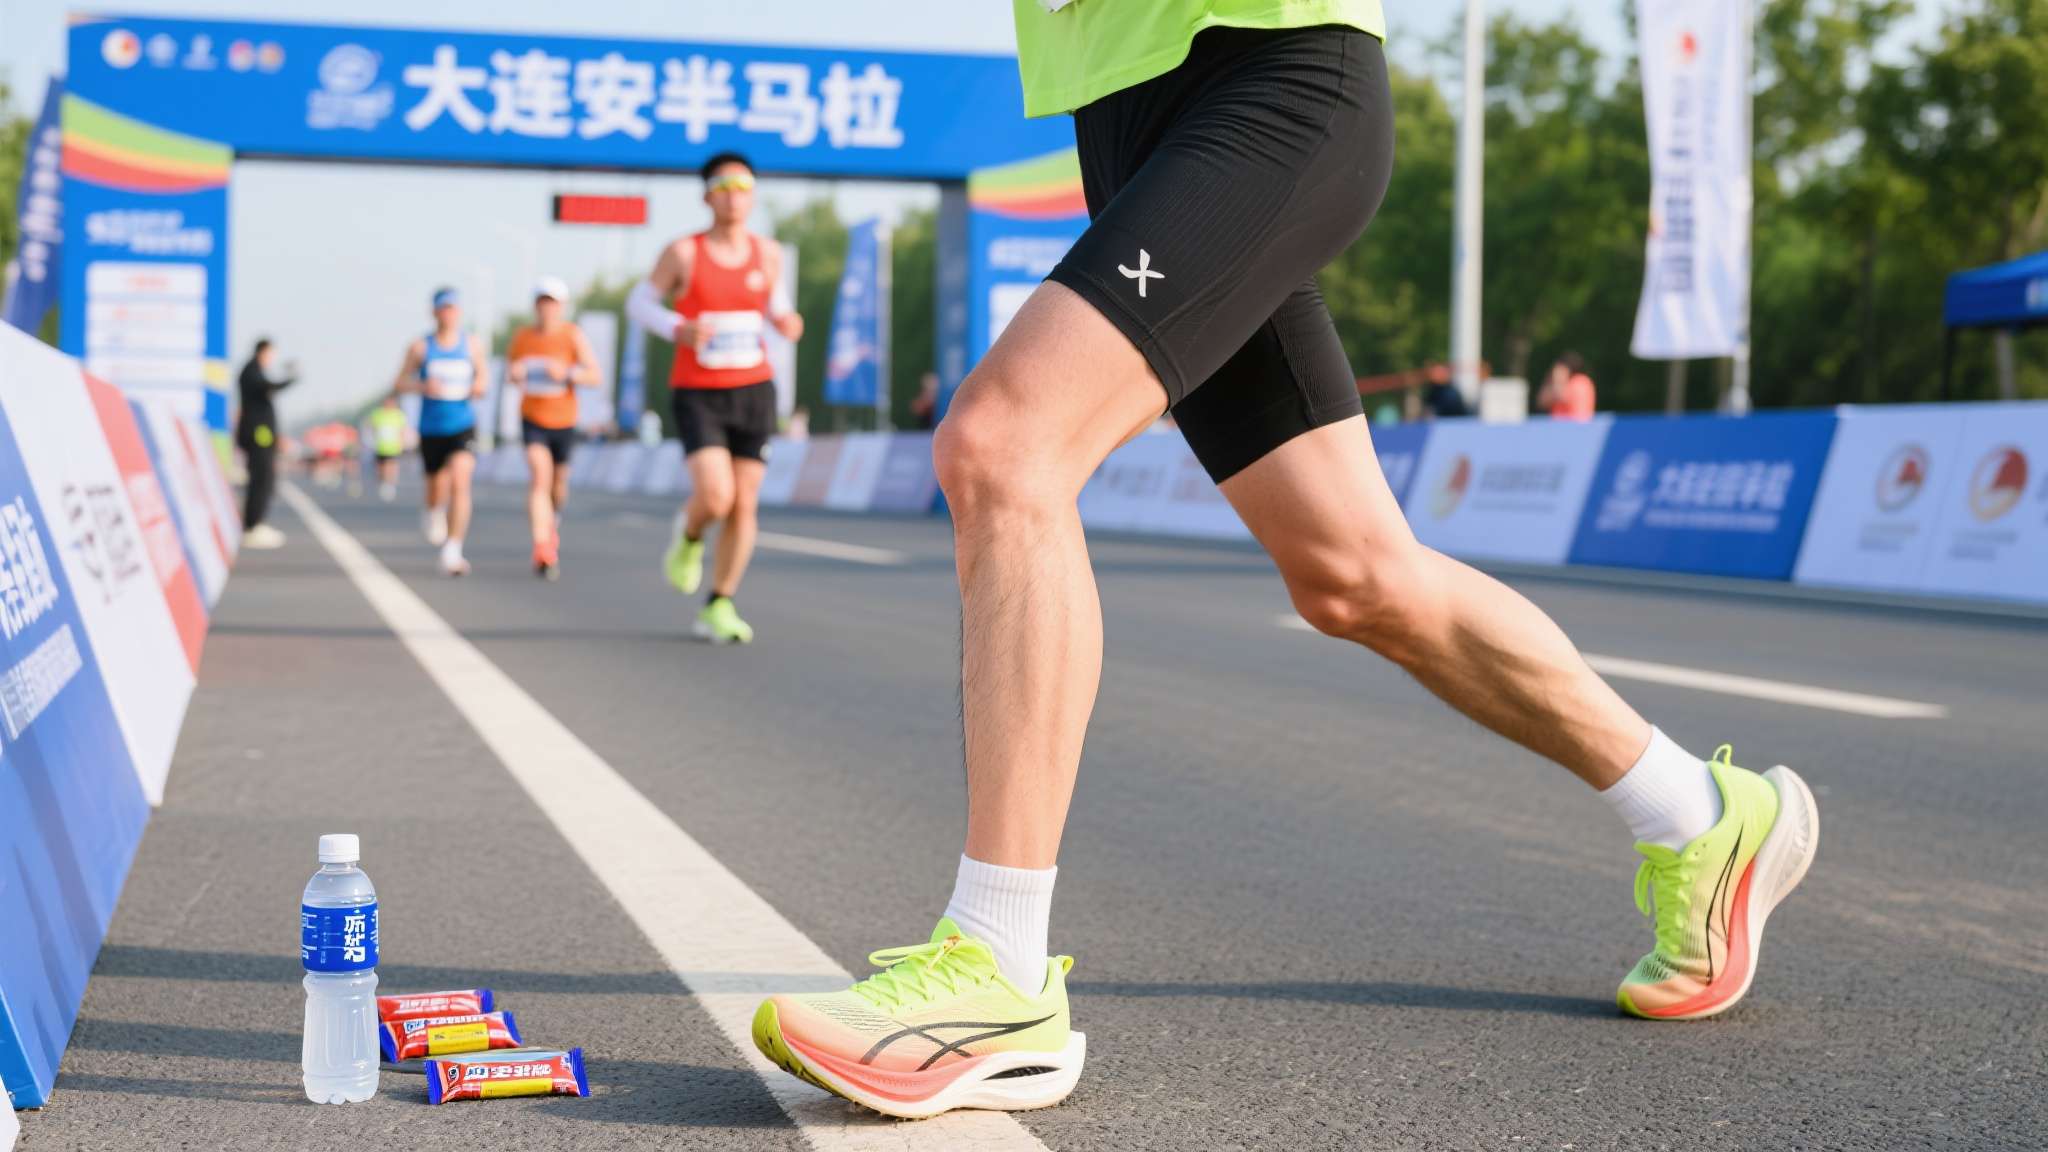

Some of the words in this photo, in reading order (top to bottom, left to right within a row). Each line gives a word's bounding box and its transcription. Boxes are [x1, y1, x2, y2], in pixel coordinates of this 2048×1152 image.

[403, 45, 903, 148] 大连安半马拉
